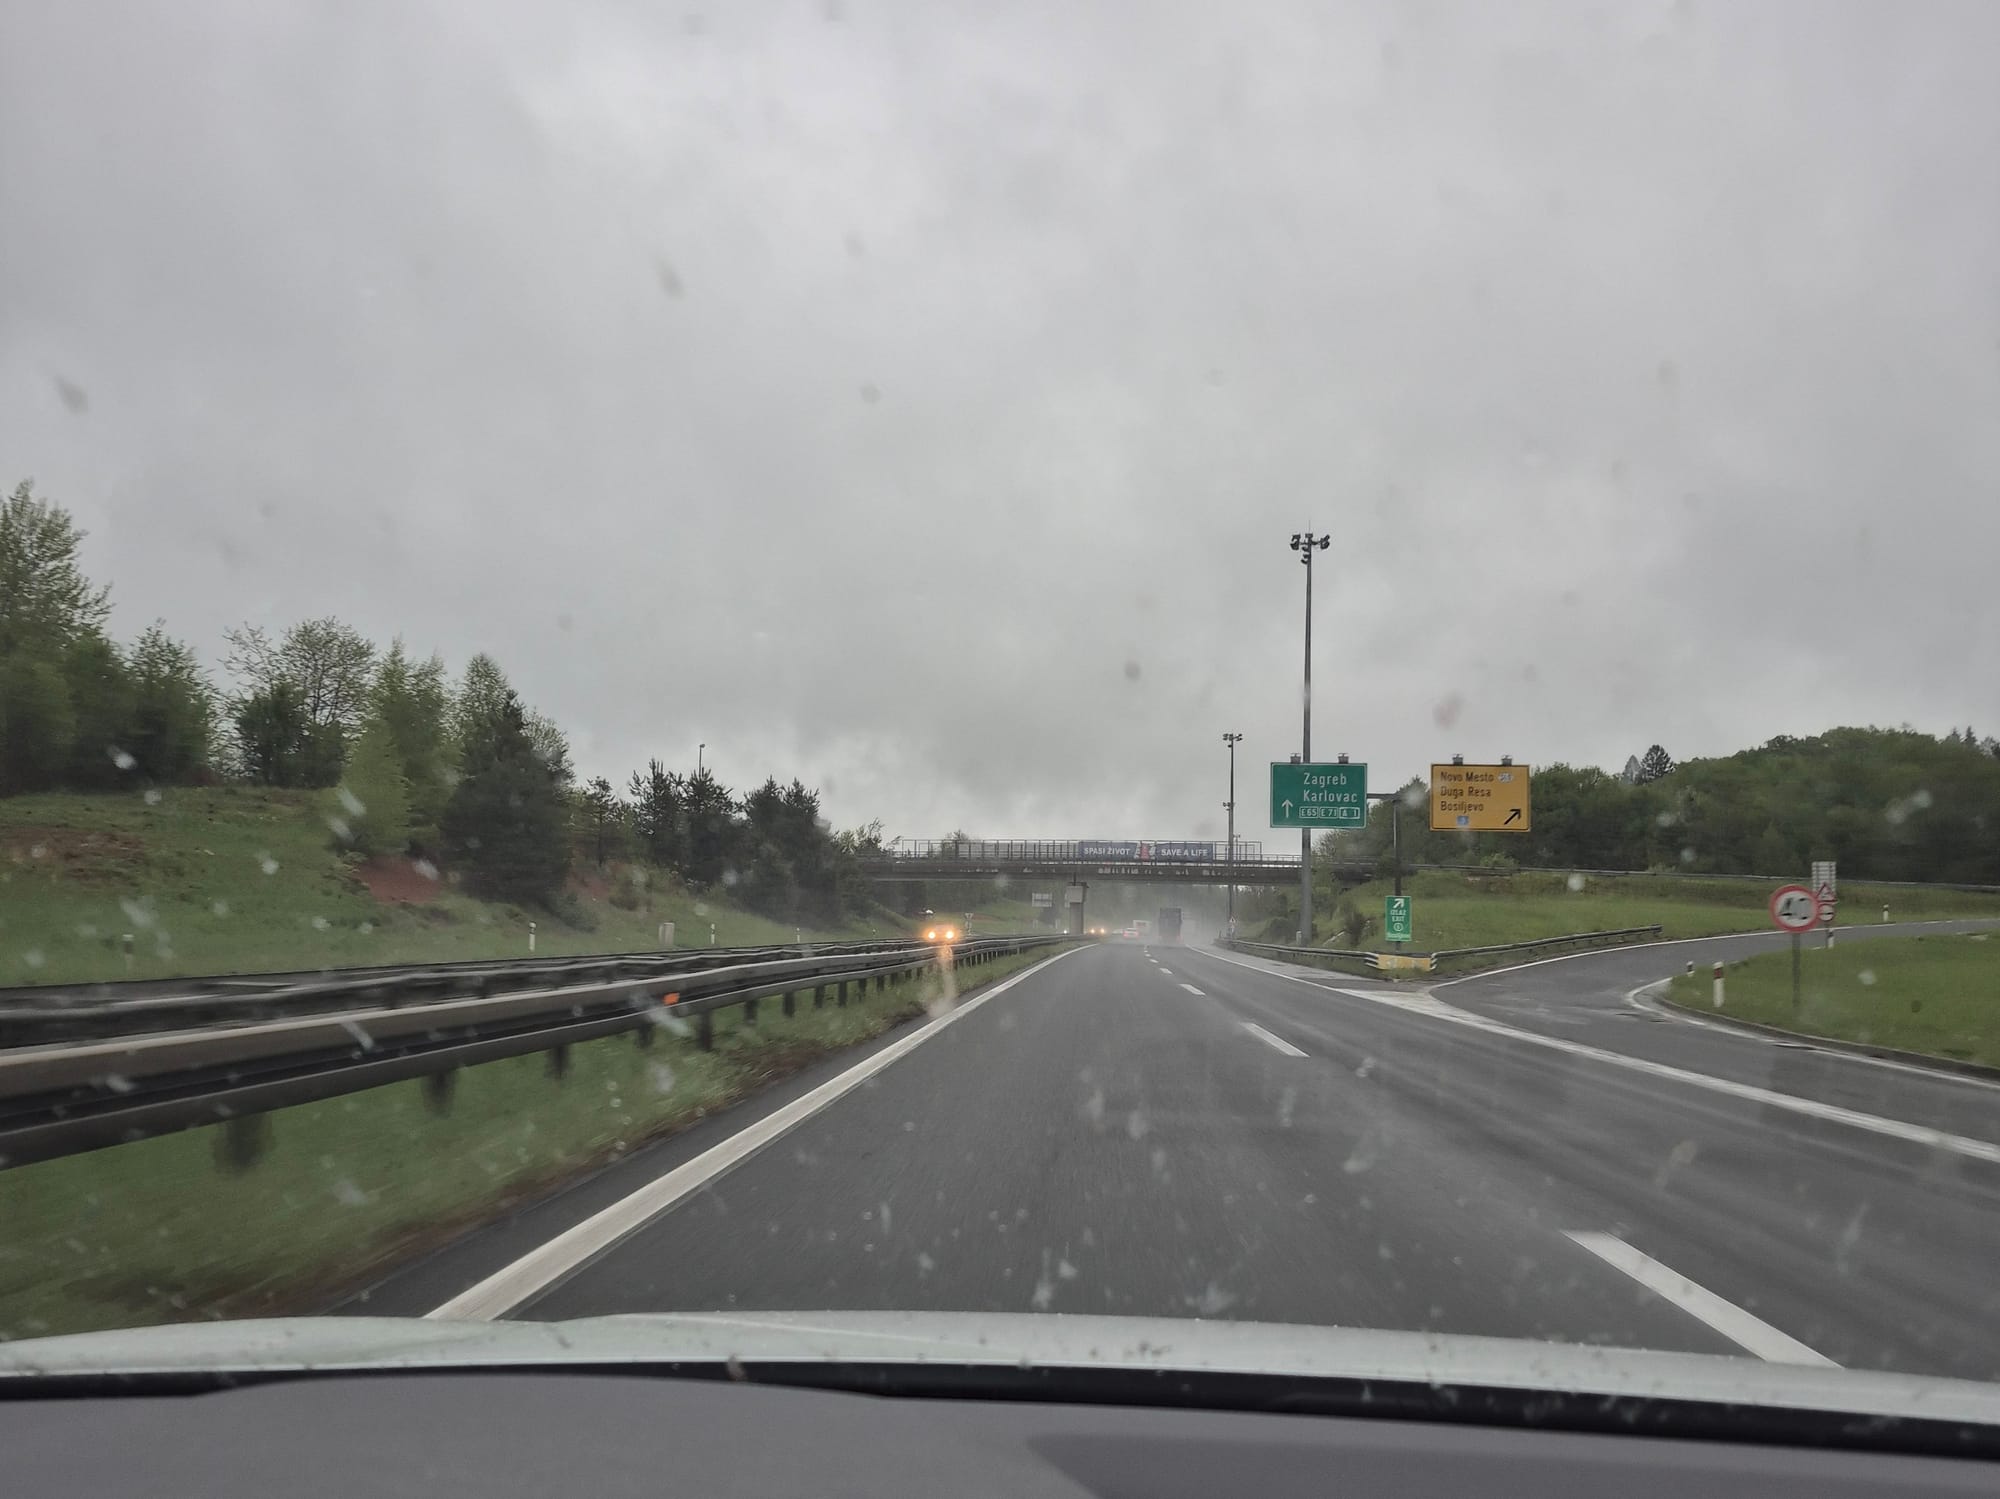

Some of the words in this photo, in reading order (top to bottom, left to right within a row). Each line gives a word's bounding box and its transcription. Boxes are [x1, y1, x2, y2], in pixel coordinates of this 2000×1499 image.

[1304, 772, 1347, 787] Zagreb
[1440, 771, 1462, 782] Novo
[1466, 772, 1494, 782] Mesto
[1303, 790, 1358, 802] Karlovac
[1440, 787, 1464, 799] Duga
[1468, 787, 1491, 797] Resa
[1440, 801, 1484, 813] Bosiljevo
[1107, 846, 1130, 855] ŽIVOT
